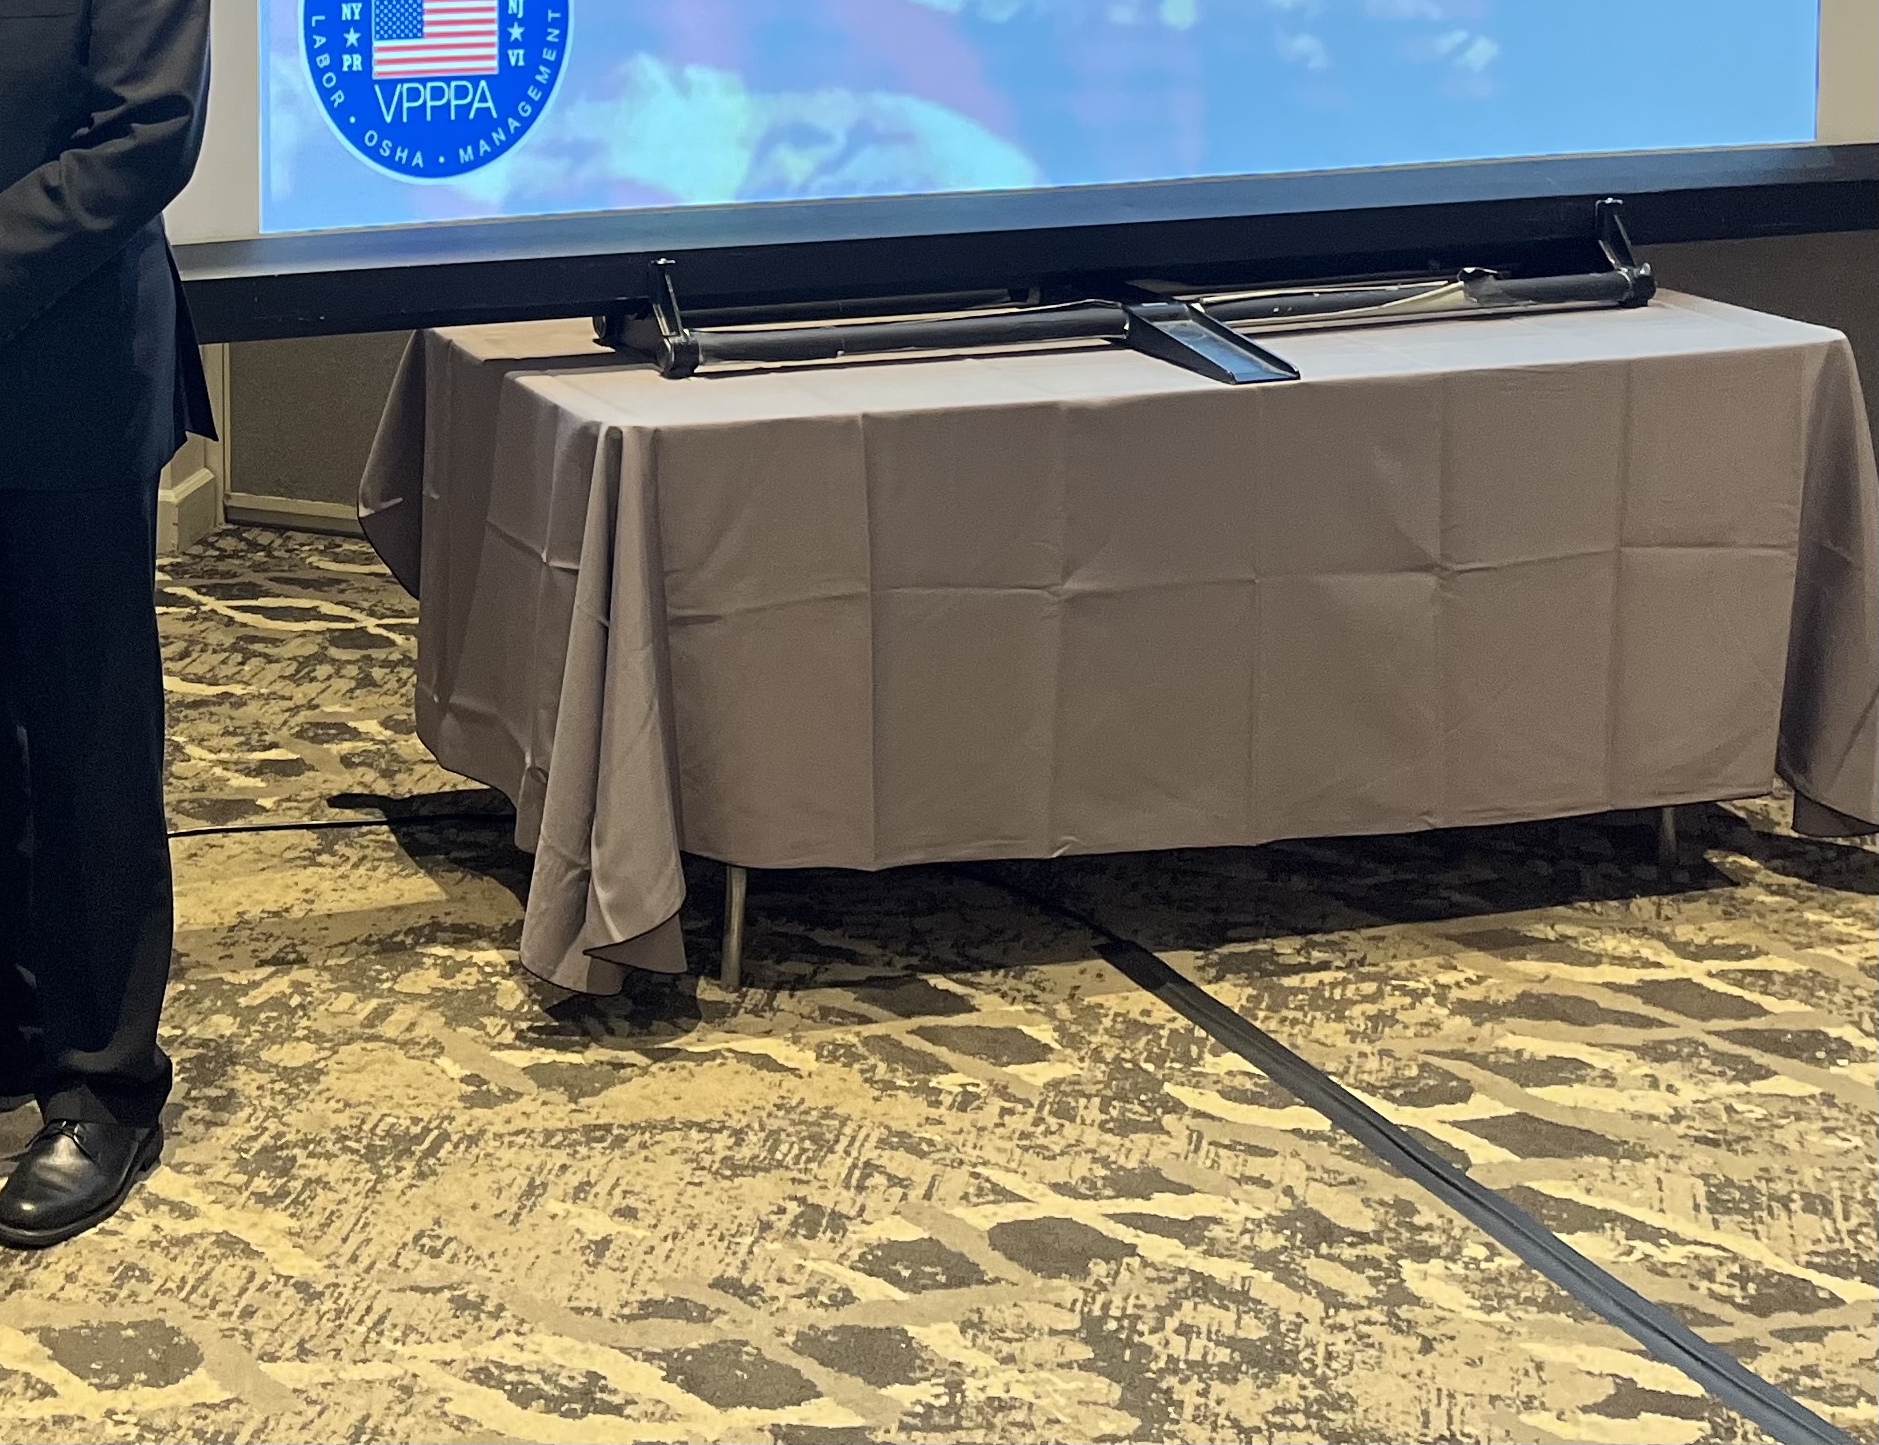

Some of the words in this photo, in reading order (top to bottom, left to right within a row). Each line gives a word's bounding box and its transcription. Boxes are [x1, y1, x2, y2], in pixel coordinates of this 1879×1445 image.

[341, 2, 363, 21] NY
[341, 53, 363, 72] PR
[507, 49, 526, 67] VI
[310, 15, 346, 109] LABOR
[364, 129, 425, 169] OSHA
[458, 9, 562, 164] MANAGEMENT
[374, 79, 498, 123] VPPPA
